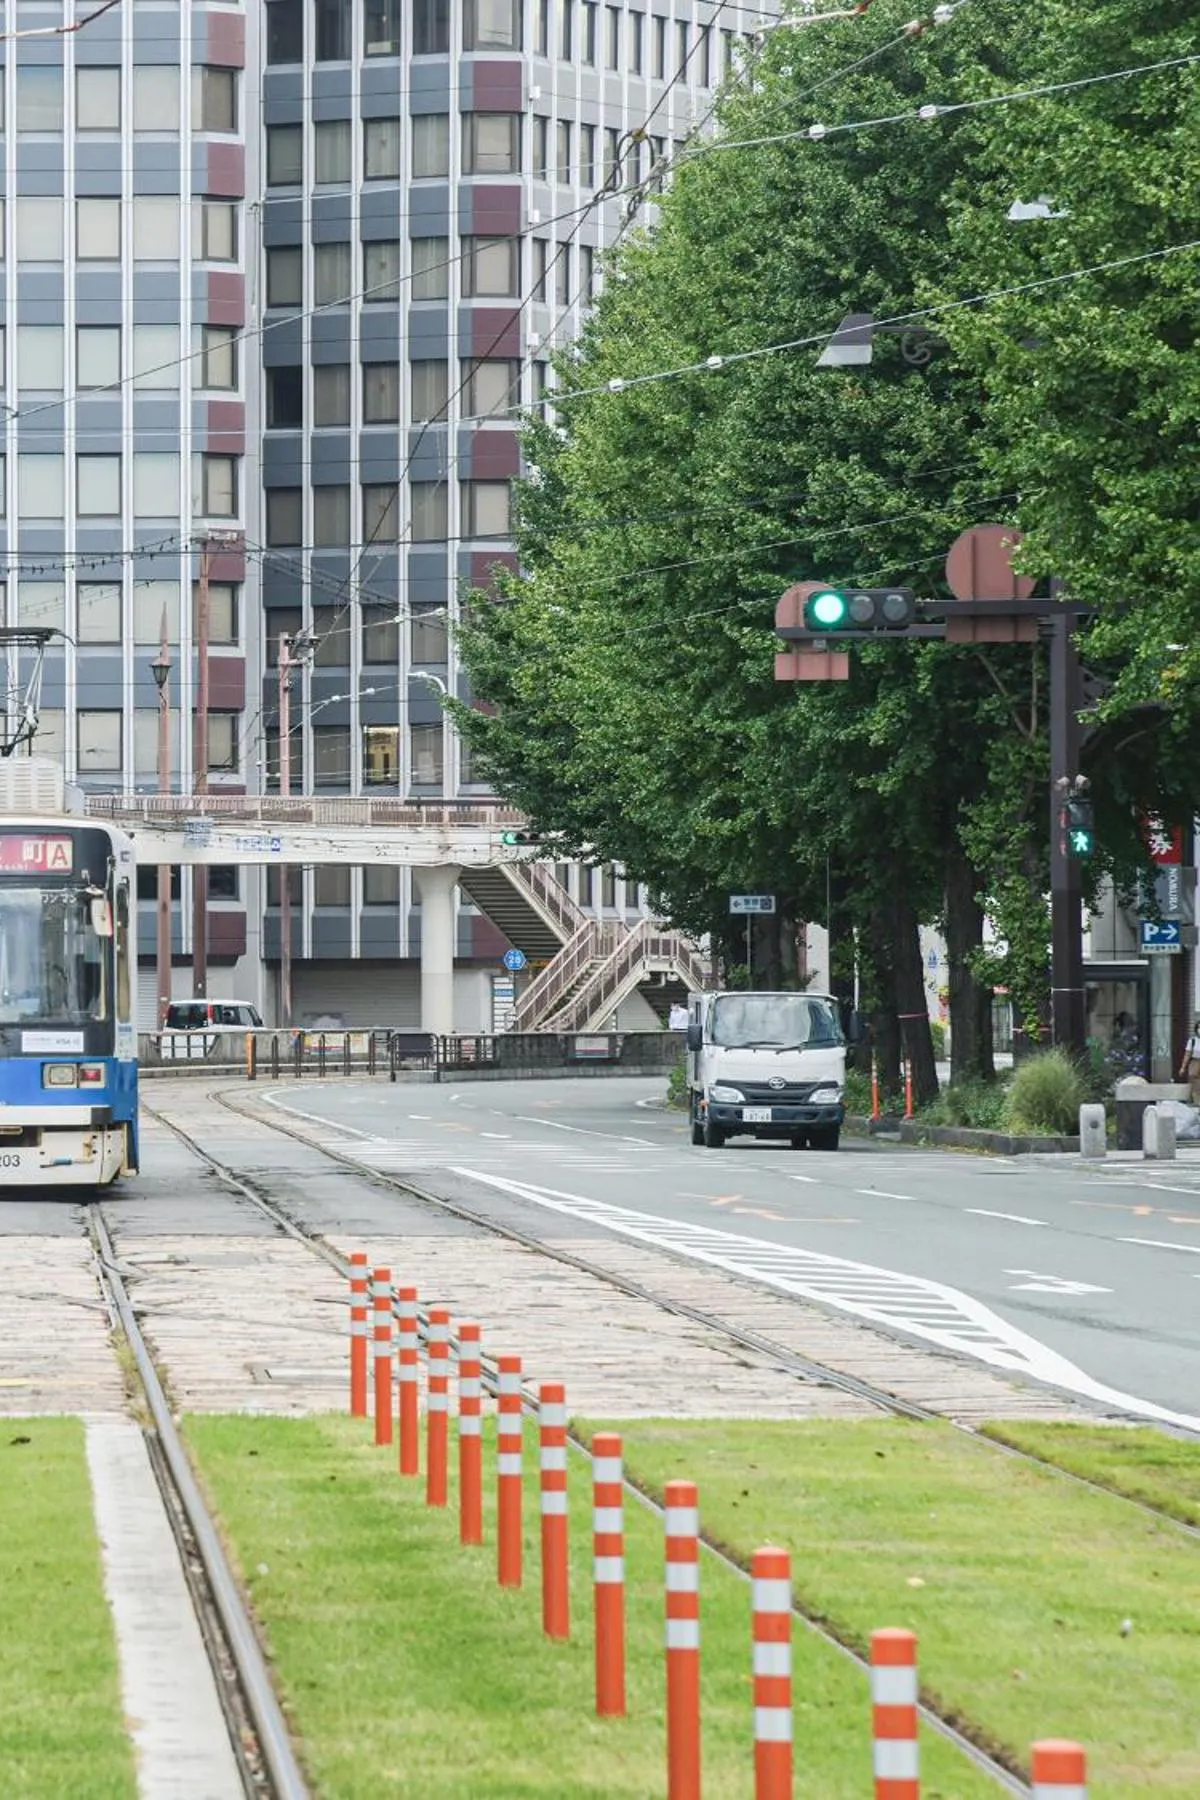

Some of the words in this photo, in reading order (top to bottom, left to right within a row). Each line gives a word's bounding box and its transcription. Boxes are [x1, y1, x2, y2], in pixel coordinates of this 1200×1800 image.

[52, 843, 69, 866] A
[1168, 867, 1178, 911] NOMURA
[1144, 922, 1159, 941] P
[508, 955, 522, 964] 28
